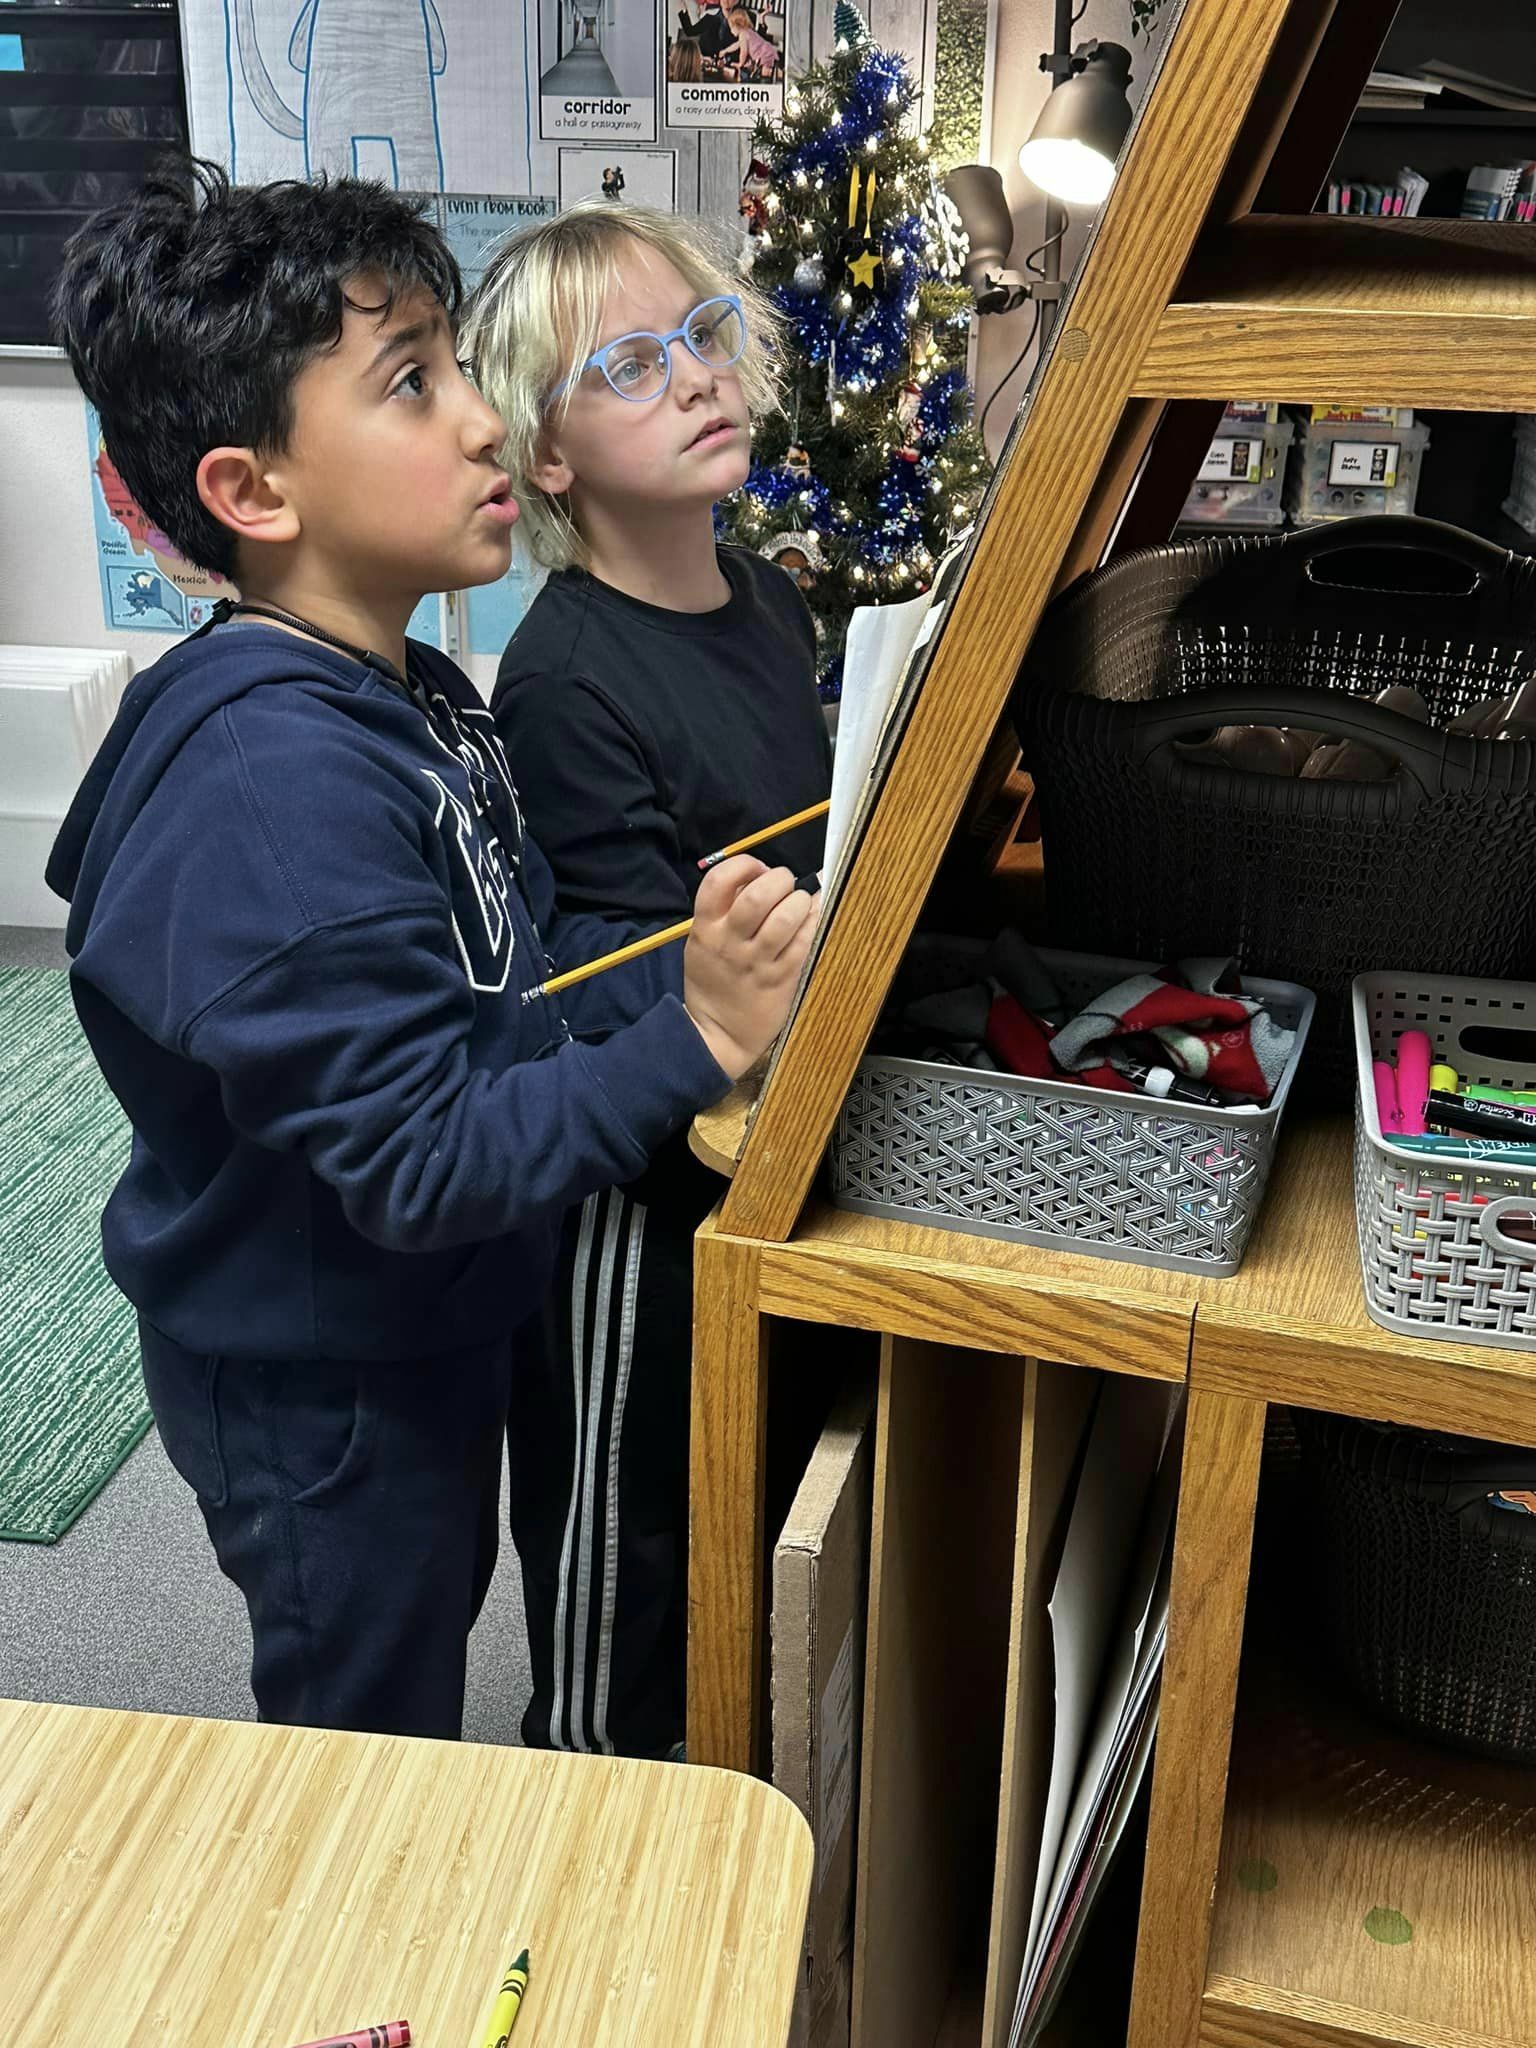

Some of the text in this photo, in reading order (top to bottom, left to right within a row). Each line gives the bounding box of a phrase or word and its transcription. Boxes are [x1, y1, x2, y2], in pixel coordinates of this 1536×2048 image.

[681, 87, 769, 102] commotion
[564, 99, 631, 115] corridor
[555, 119, 561, 127] a
[563, 117, 577, 127] hall
[448, 200, 549, 216] EVENT FROM BOOK
[173, 574, 207, 585] Mexico
[1477, 1103, 1515, 1119] Scented
